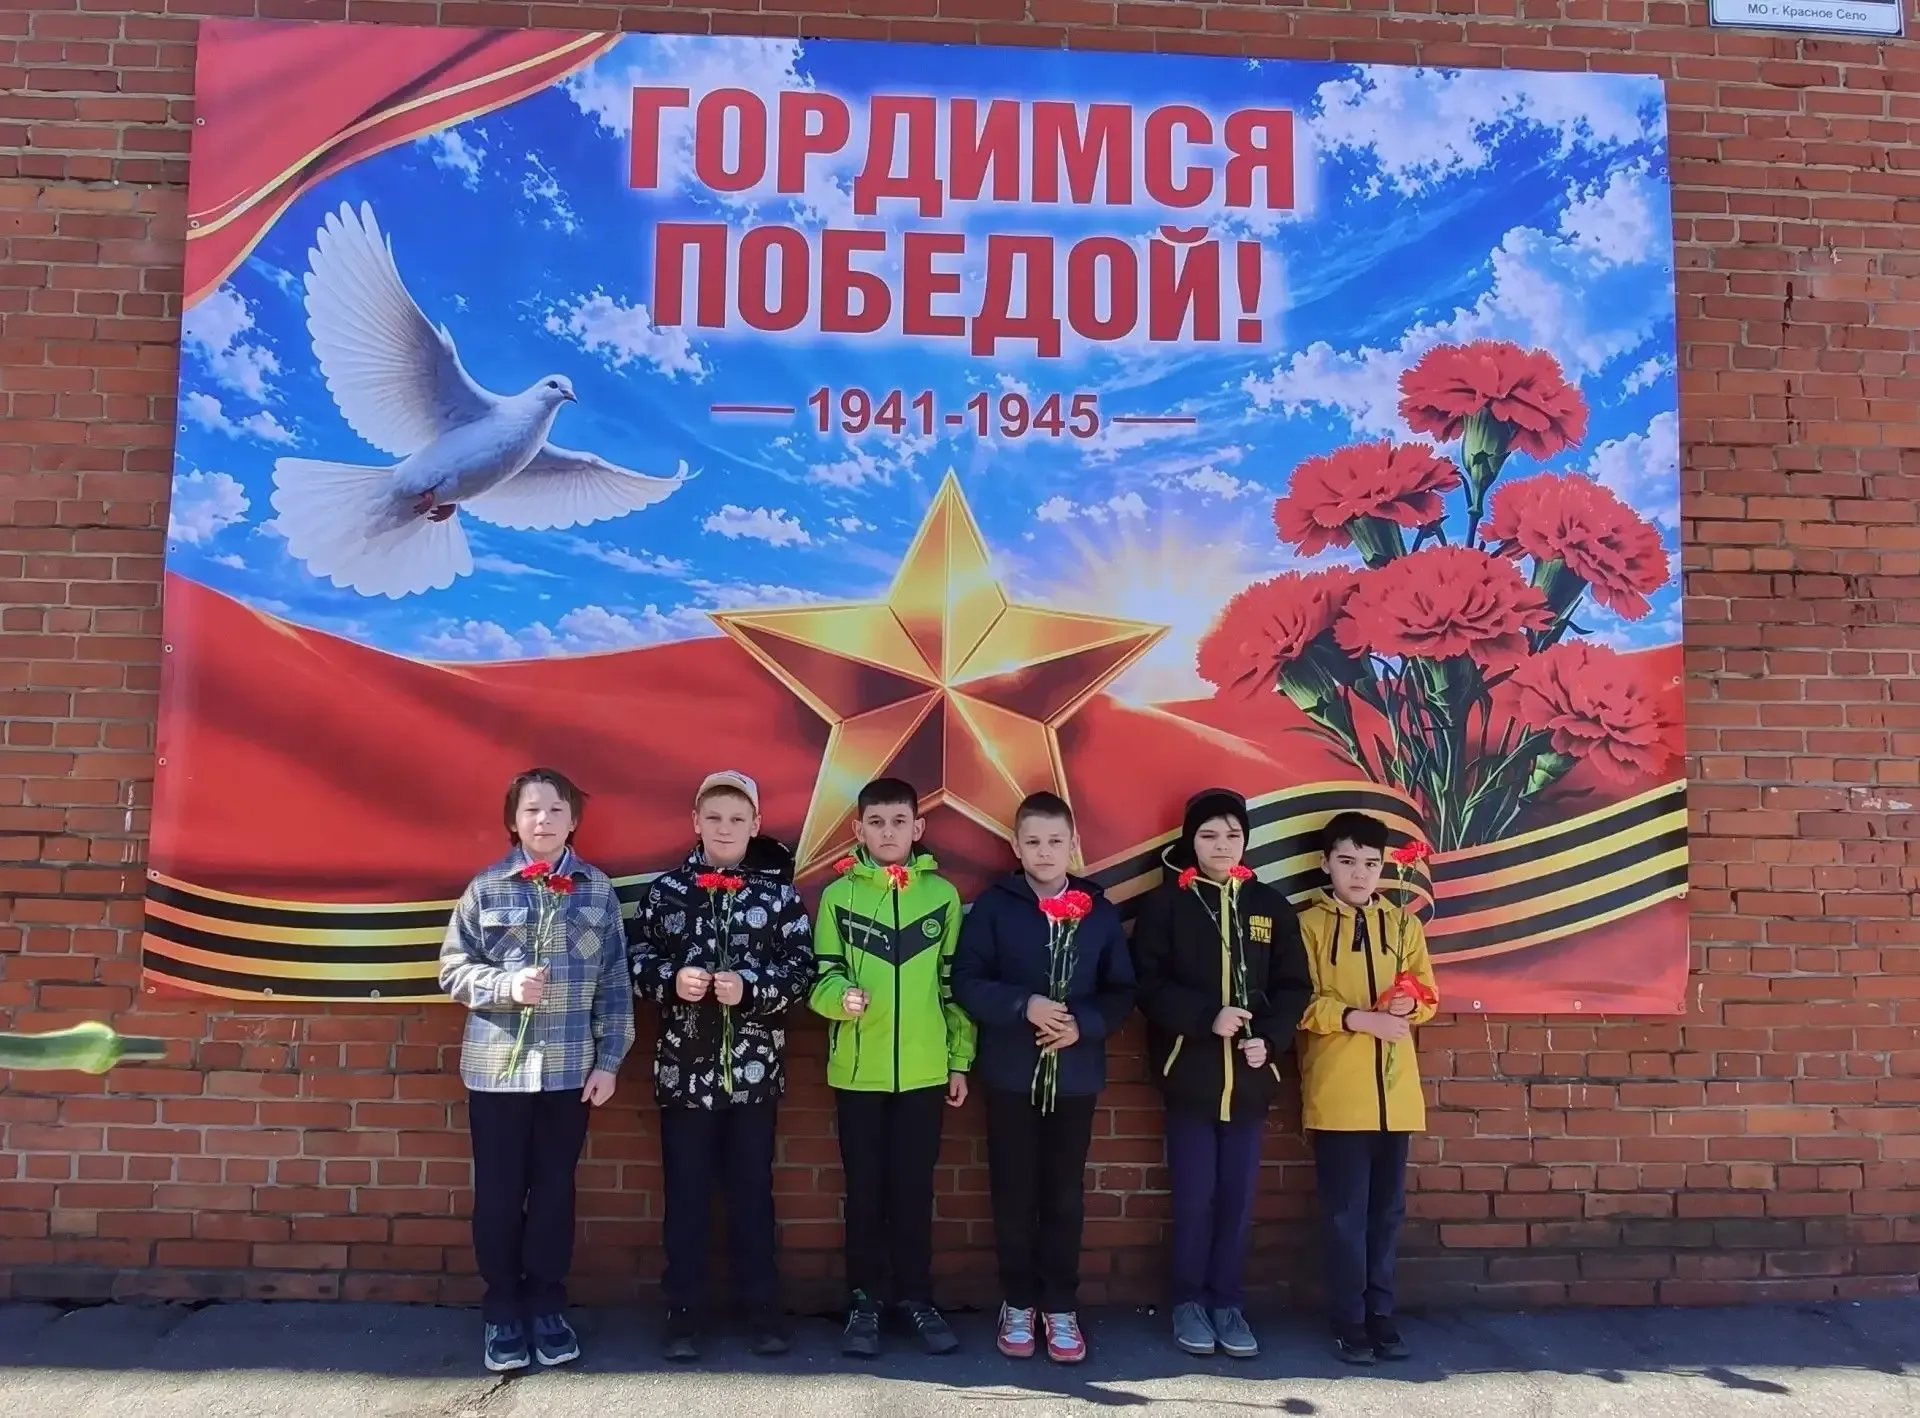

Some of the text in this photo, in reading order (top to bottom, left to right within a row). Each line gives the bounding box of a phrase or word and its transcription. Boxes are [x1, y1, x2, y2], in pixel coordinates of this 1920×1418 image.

[1748, 4, 1868, 21] МО г. Красное Село
[629, 86, 1295, 218] ГОРДИМСЯ
[652, 221, 1264, 358] ПОБЕДОЙ!
[807, 386, 1100, 438] 1941-1945
